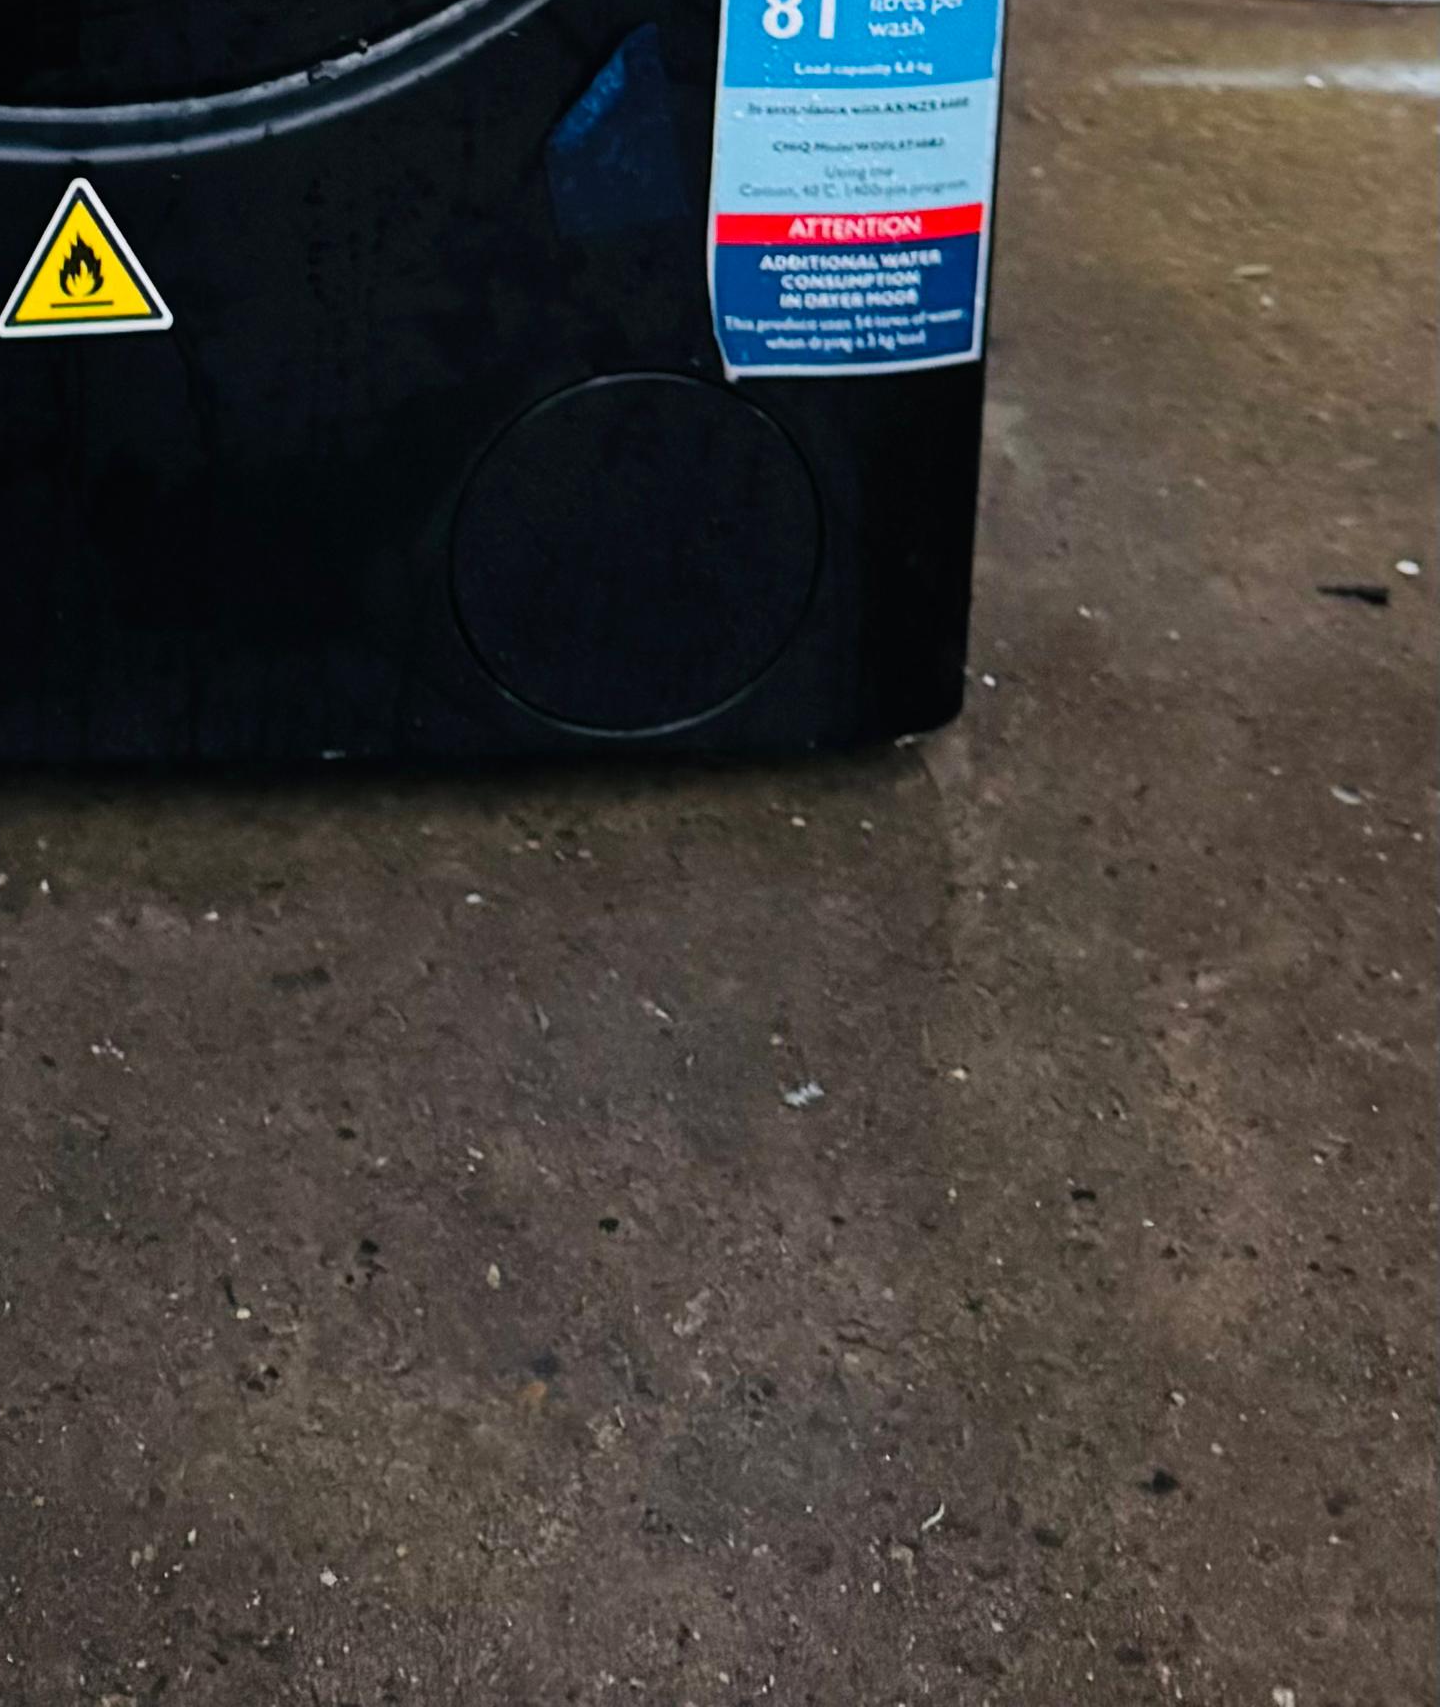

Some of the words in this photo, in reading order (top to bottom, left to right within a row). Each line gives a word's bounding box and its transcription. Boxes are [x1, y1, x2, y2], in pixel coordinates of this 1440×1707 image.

[868, 18, 924, 37] wash
[788, 215, 922, 240] ATTENTION
[759, 254, 879, 272] ADDITIONAL
[880, 248, 942, 268] WATER
[780, 269, 922, 291] CONSUMPTION
[779, 292, 803, 310] IN
[803, 292, 864, 309] DRYER
[865, 287, 919, 308] MODE
